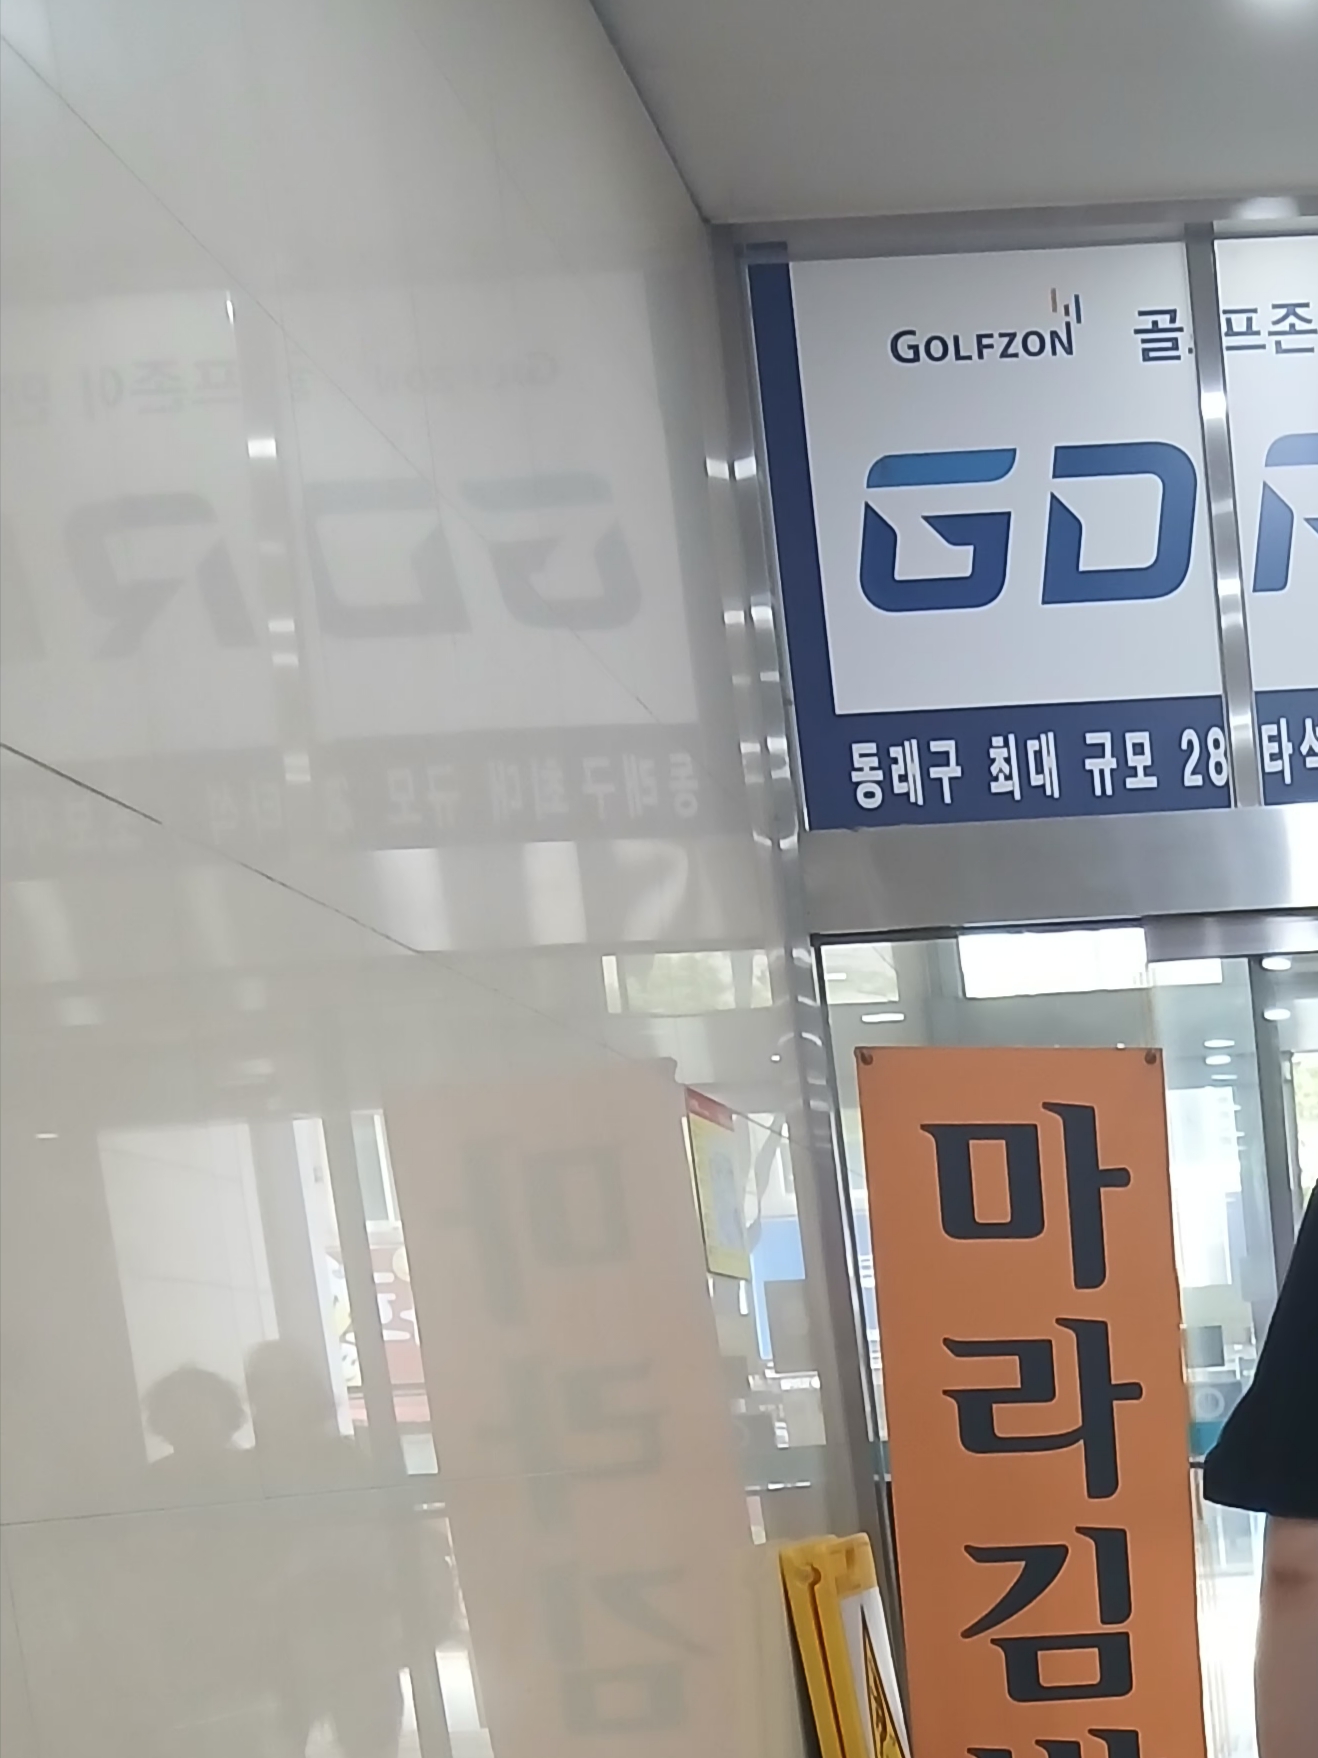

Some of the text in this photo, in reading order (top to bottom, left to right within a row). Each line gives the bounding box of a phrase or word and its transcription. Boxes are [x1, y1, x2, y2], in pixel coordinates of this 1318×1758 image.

[889, 320, 1075, 364] GOLFZON
[850, 738, 962, 809] 동래구
[988, 732, 1060, 800] 최대
[1084, 730, 1158, 793] 규모
